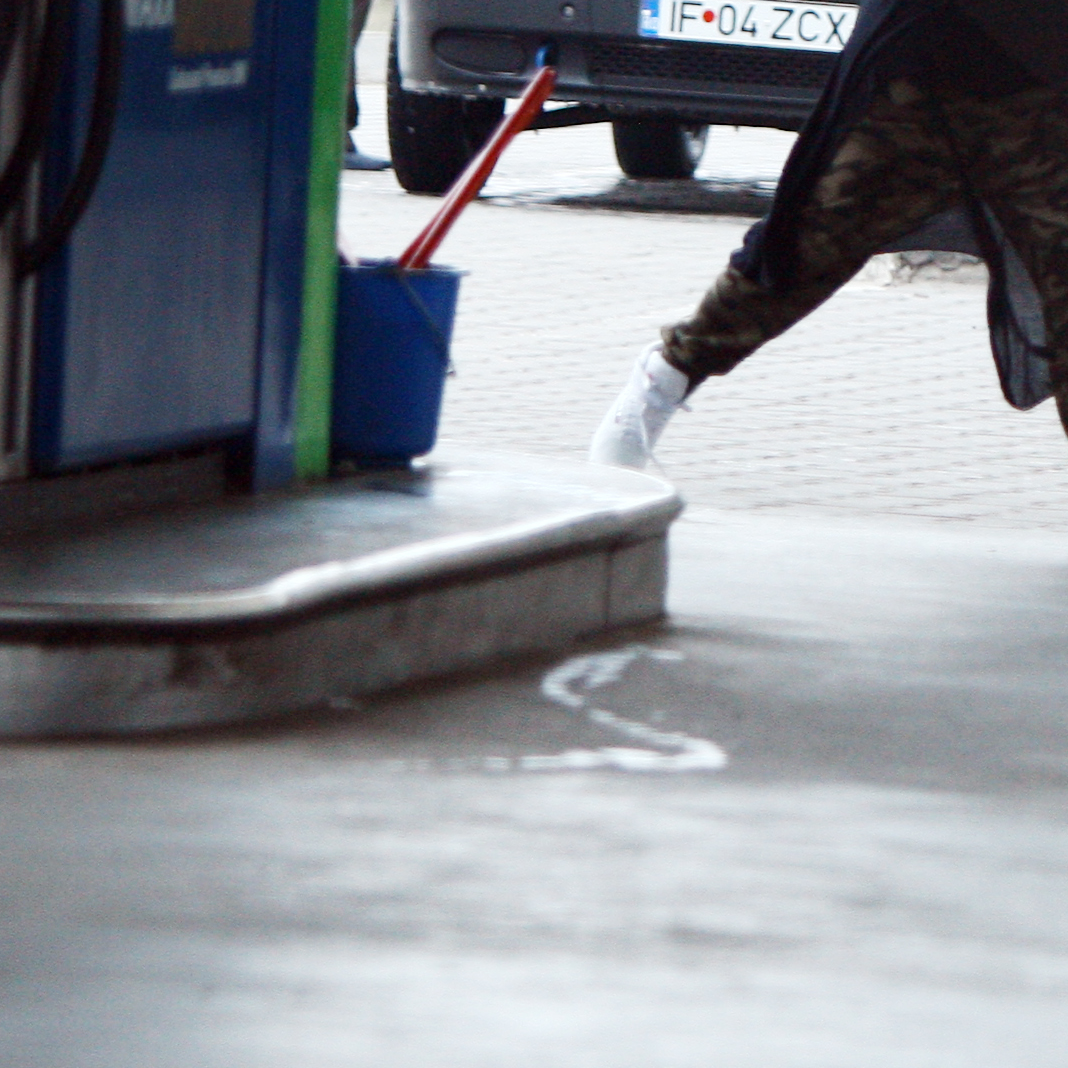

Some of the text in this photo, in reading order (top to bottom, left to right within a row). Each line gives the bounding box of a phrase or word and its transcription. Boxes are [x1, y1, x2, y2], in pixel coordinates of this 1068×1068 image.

[670, 0, 703, 32] IF
[718, 4, 757, 37] 04
[771, 7, 846, 47] ZCX
